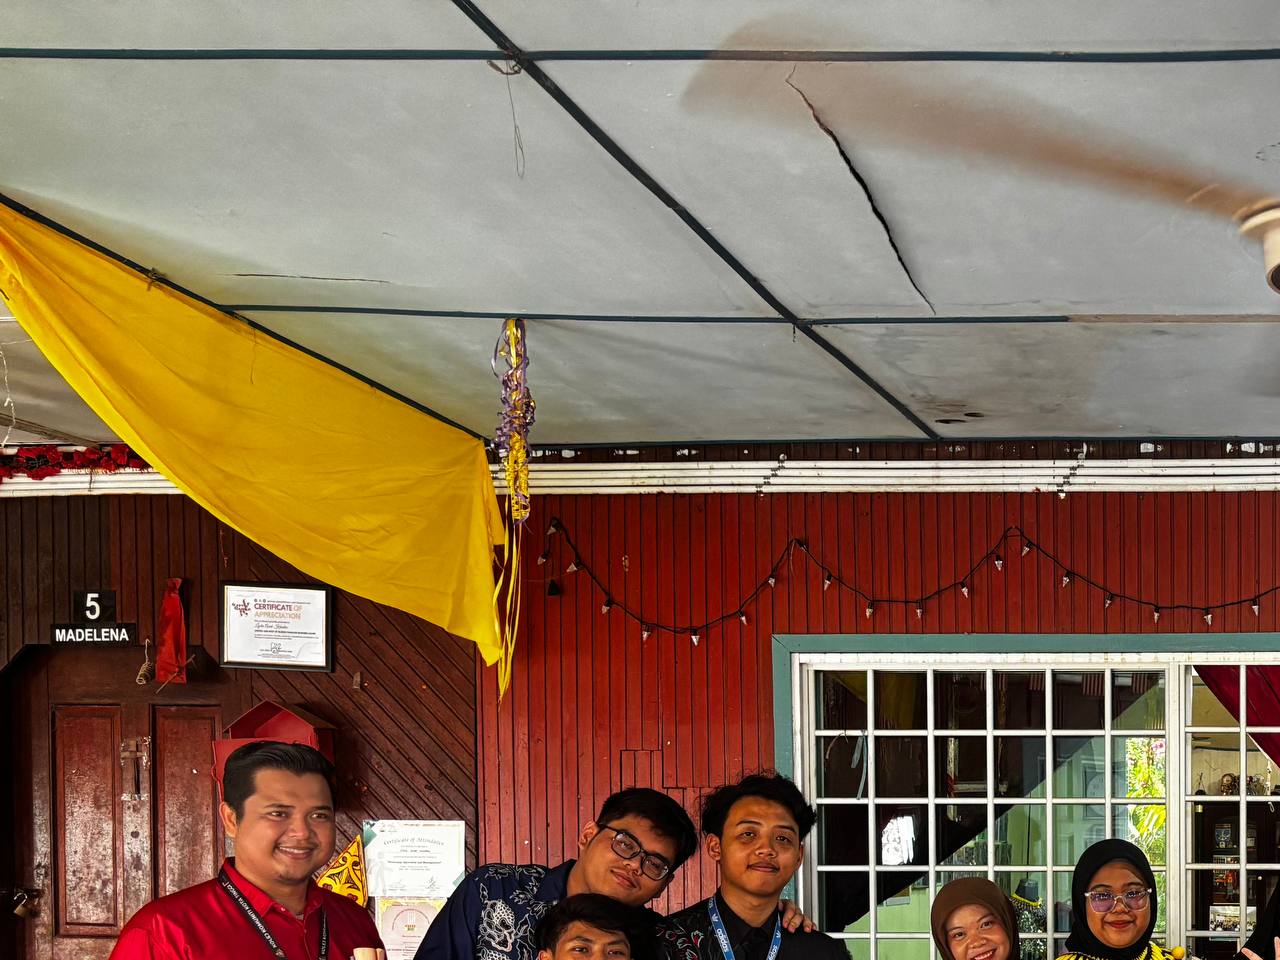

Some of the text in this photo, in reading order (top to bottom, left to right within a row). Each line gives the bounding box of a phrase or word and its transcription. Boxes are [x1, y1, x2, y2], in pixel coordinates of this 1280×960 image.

[86, 593, 100, 619] 5
[254, 603, 303, 612] CERTIFICATE OF
[254, 611, 301, 620] APPRECIATION
[56, 628, 129, 642] MADELENA
[237, 897, 250, 912] KOTA
[716, 928, 730, 953] adidas
